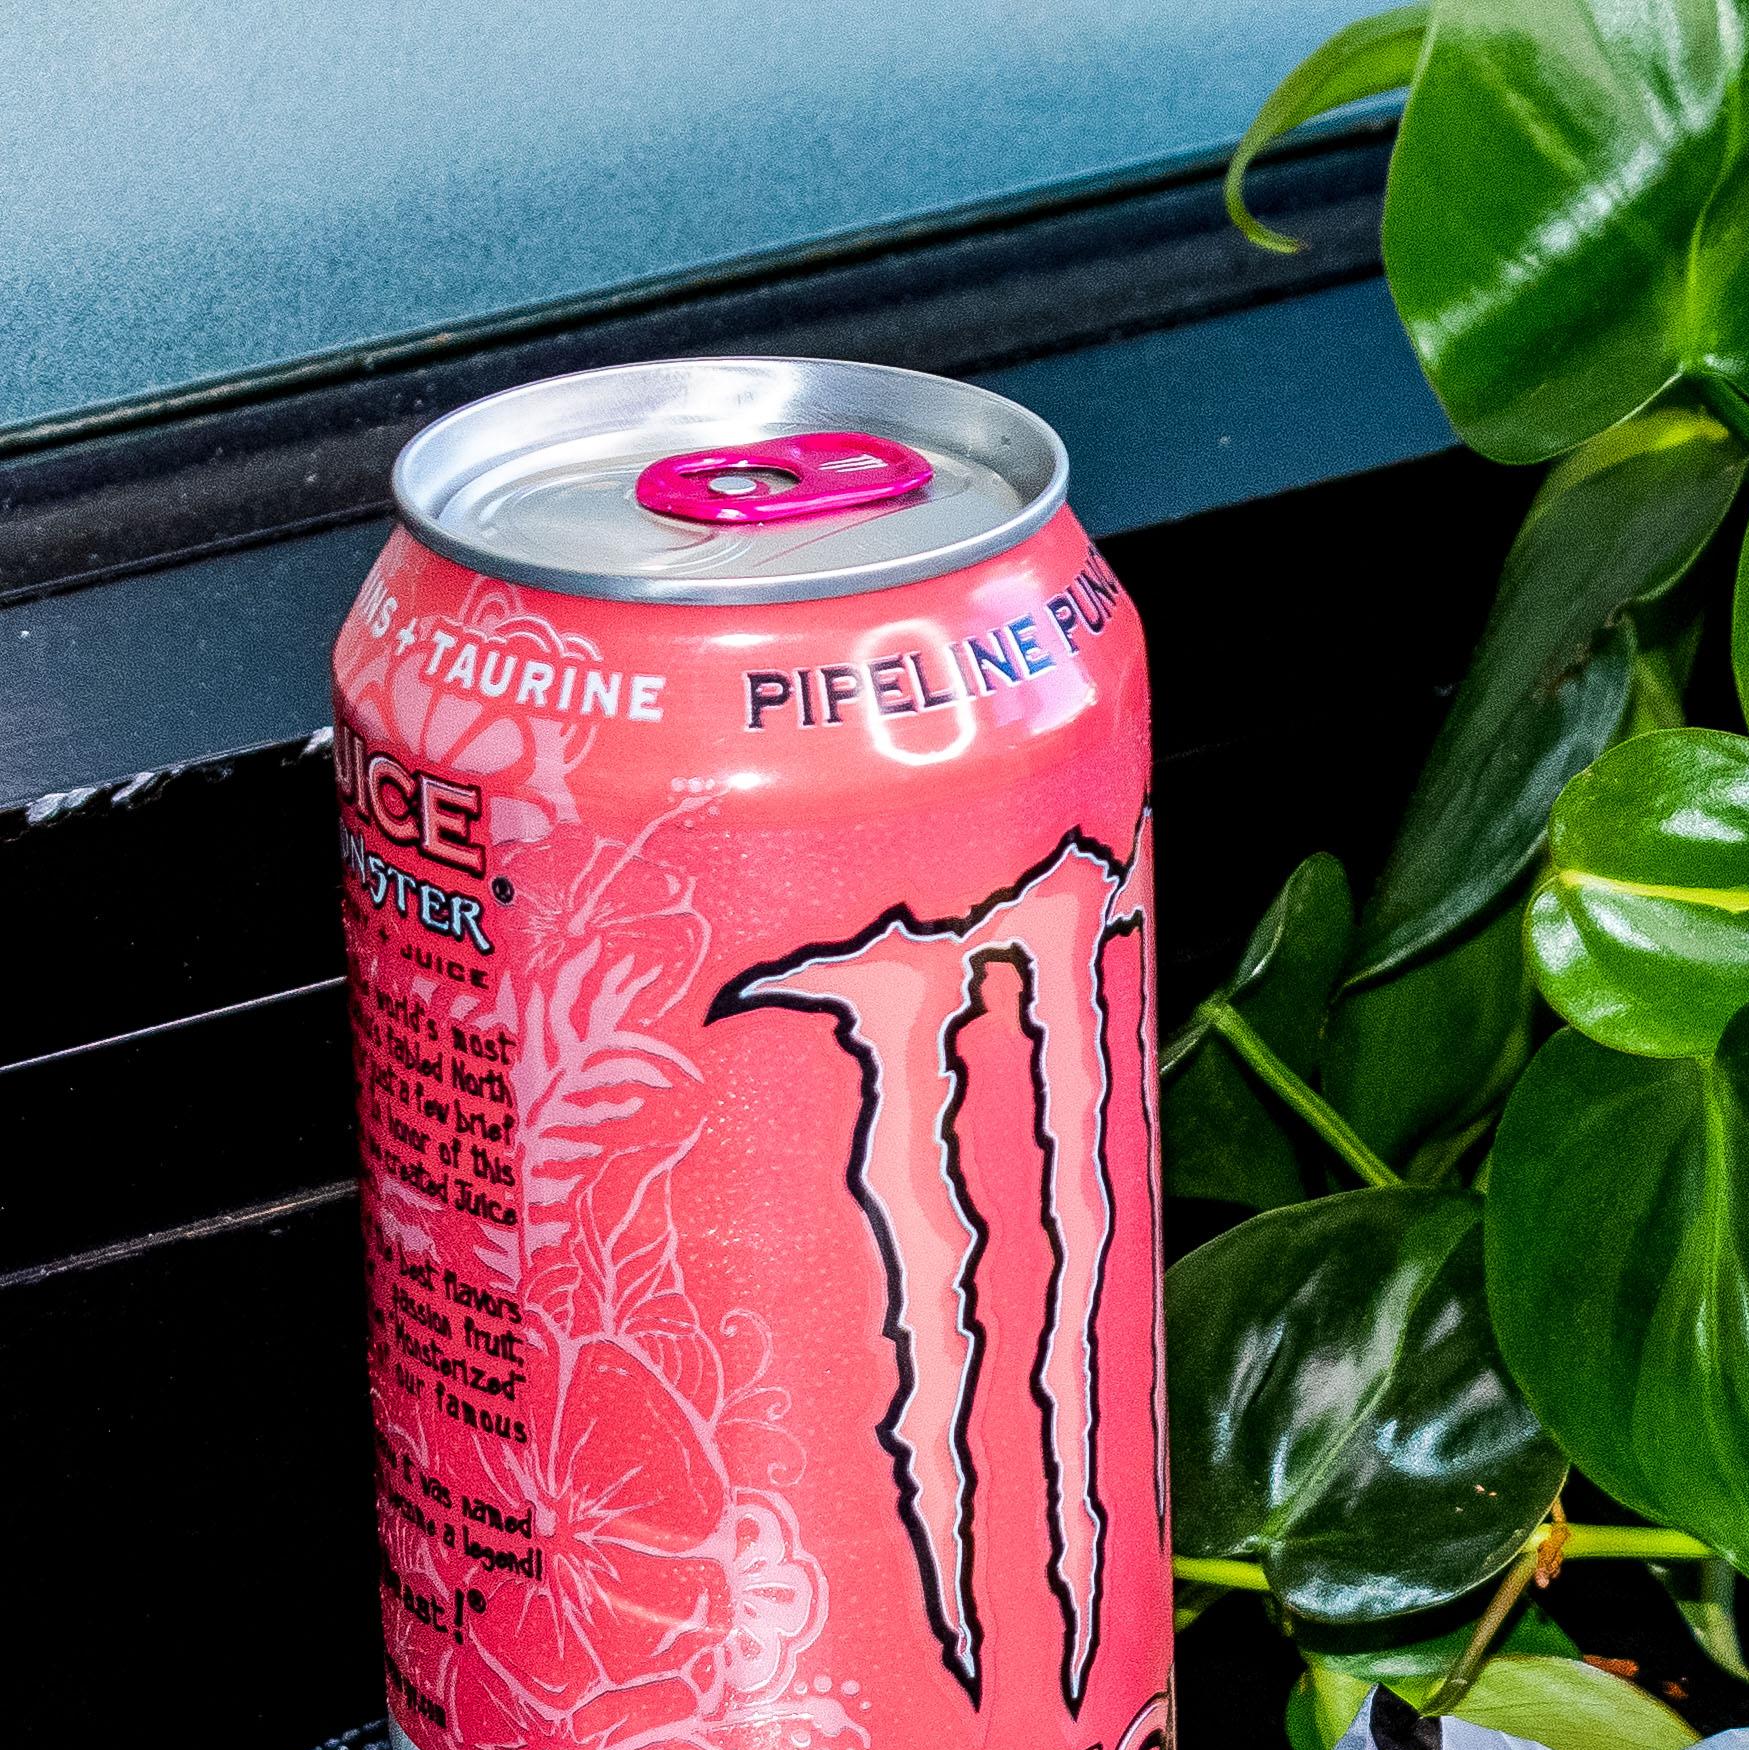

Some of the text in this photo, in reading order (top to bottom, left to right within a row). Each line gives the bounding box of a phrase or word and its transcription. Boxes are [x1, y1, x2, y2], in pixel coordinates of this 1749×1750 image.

[425, 629, 667, 723] TAURINE
[743, 612, 1059, 732] PIPELINE
[334, 723, 487, 880] UICE
[340, 815, 495, 957] NSTER
[402, 943, 490, 991] JUICE
[452, 1056, 514, 1109] North
[454, 1100, 517, 1147] brief
[438, 1137, 461, 1168] of
[470, 1143, 517, 1188] this
[453, 1178, 519, 1227] Juice
[443, 1267, 523, 1325] flavors
[434, 1380, 528, 1444] famous
[461, 1494, 533, 1540] named
[443, 1522, 456, 1549] a
[462, 1524, 543, 1582] legend!
